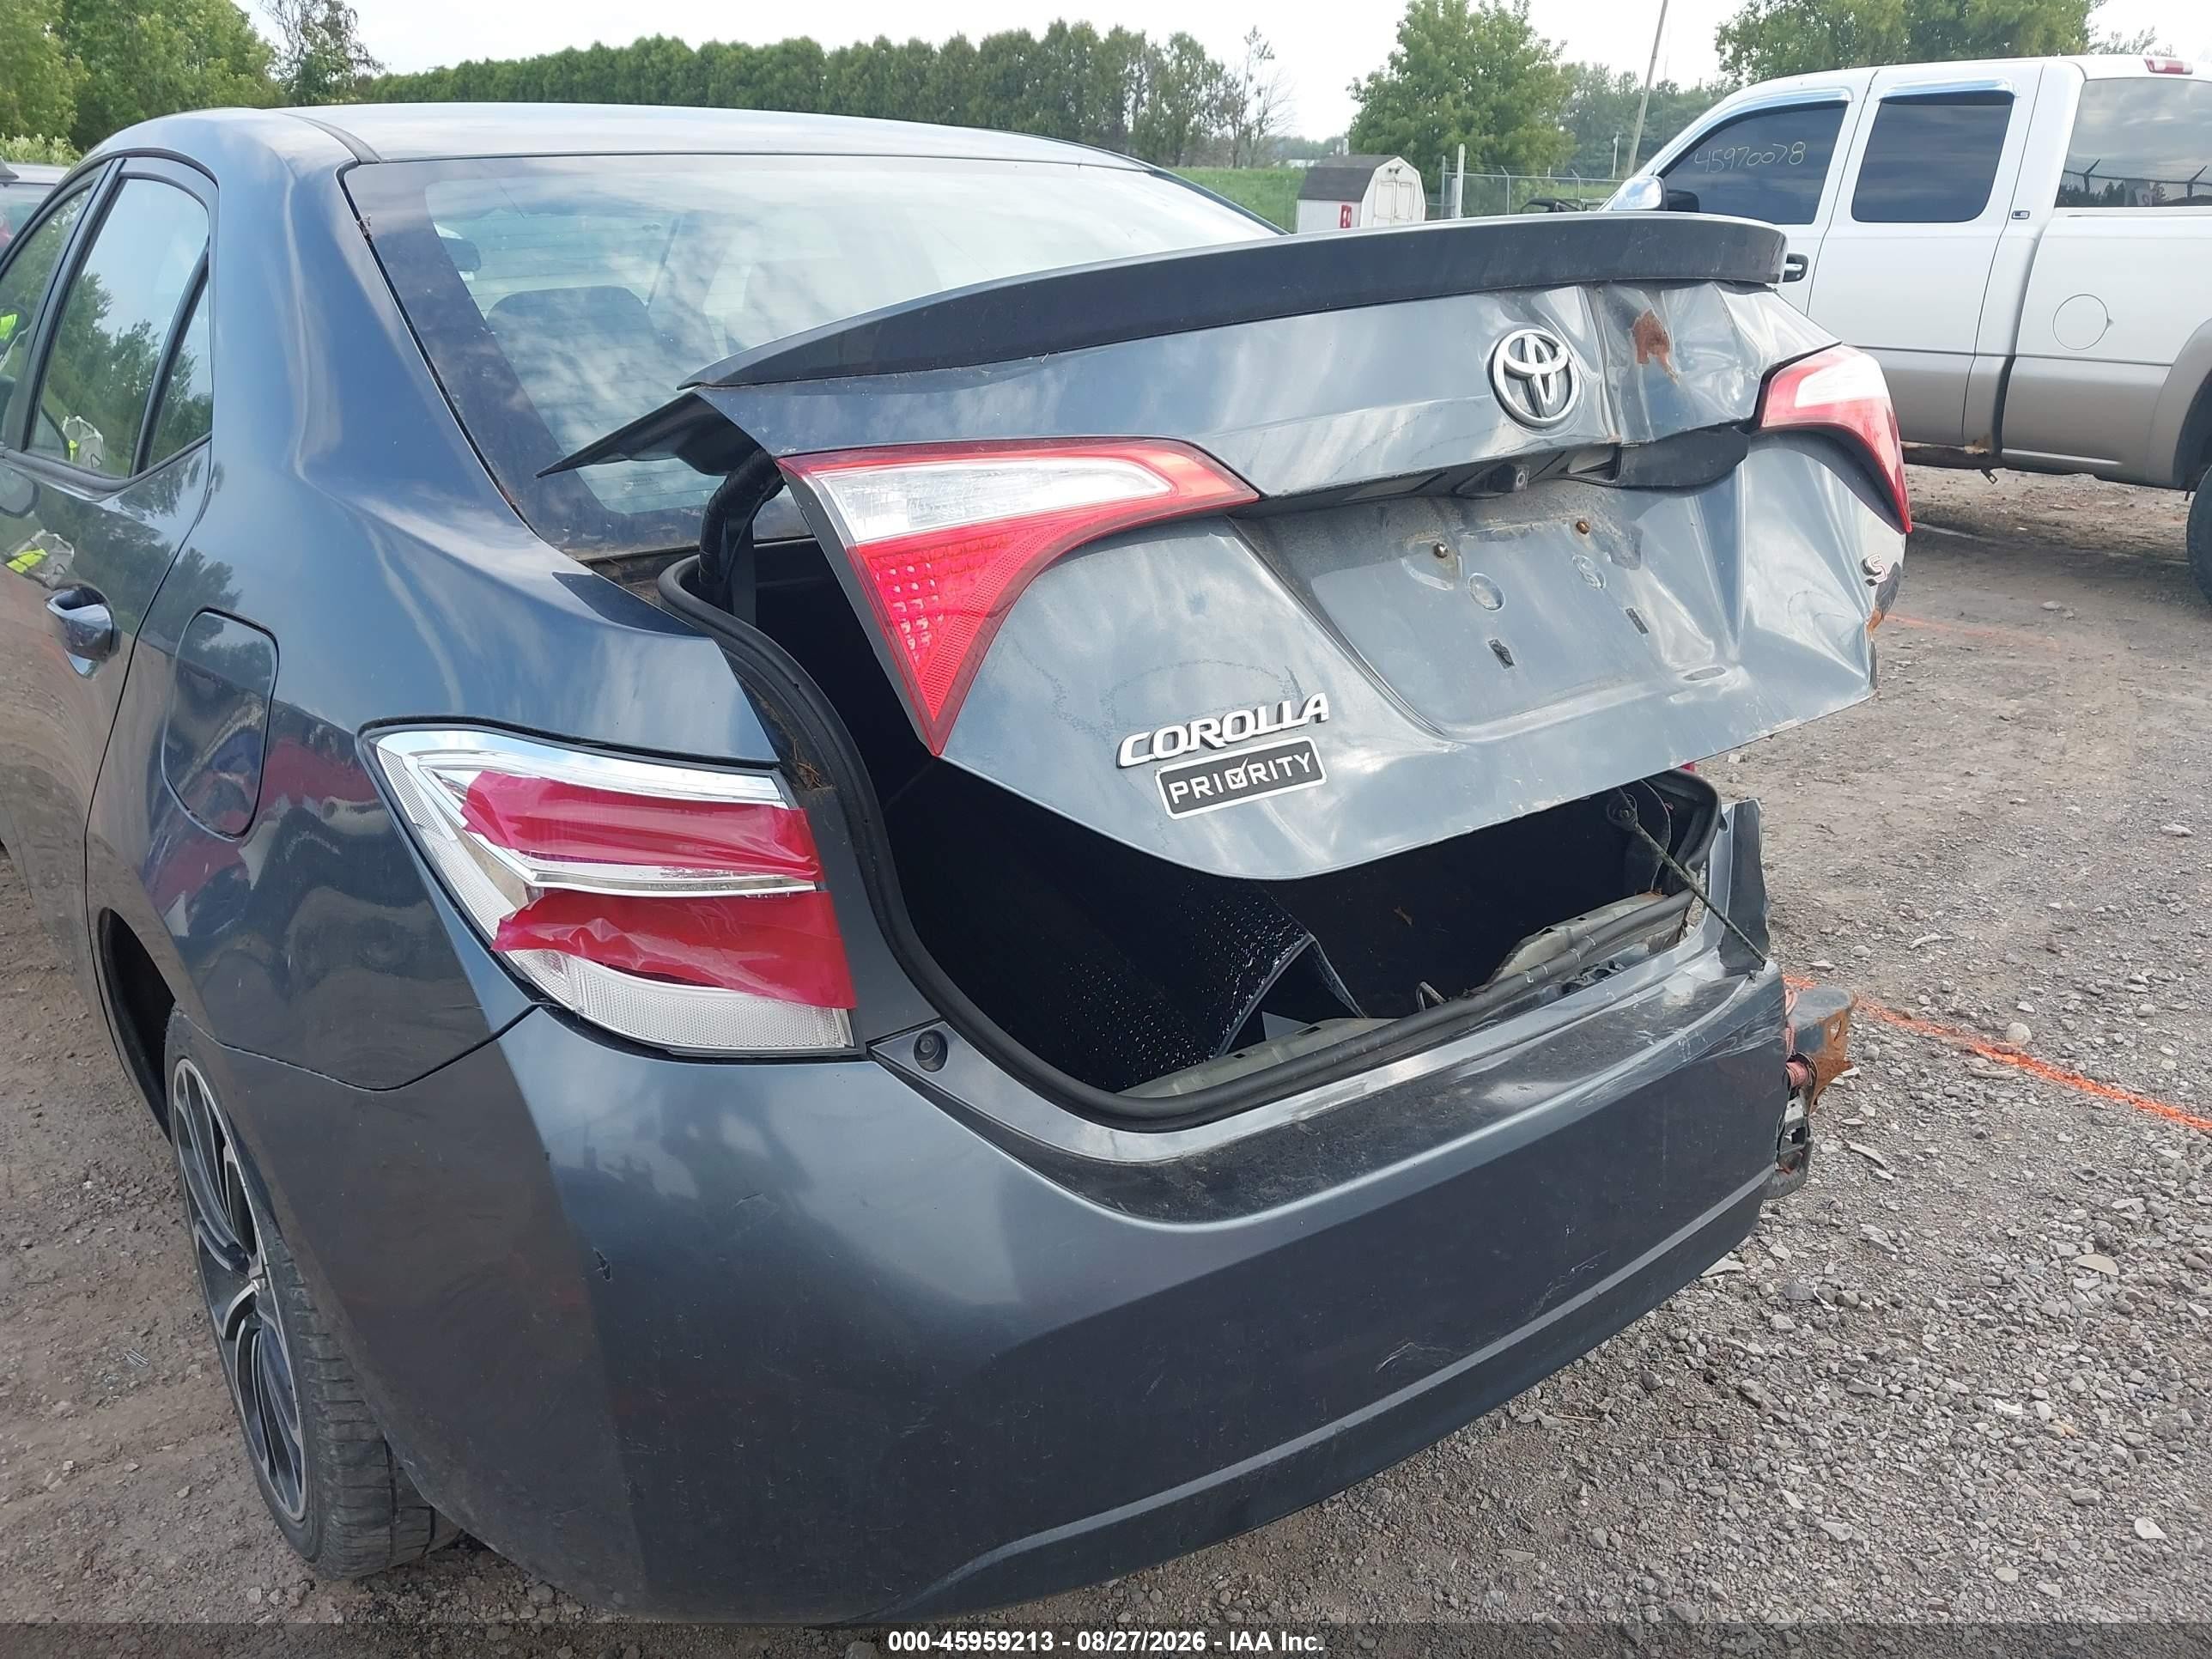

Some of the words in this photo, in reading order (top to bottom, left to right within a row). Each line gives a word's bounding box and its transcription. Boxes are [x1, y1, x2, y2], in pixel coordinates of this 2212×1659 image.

[1694, 141, 1806, 173] 45970078
[1864, 554, 1888, 585] S
[1118, 692, 1330, 768] COROLLA
[1168, 751, 1311, 805] PRIORITY
